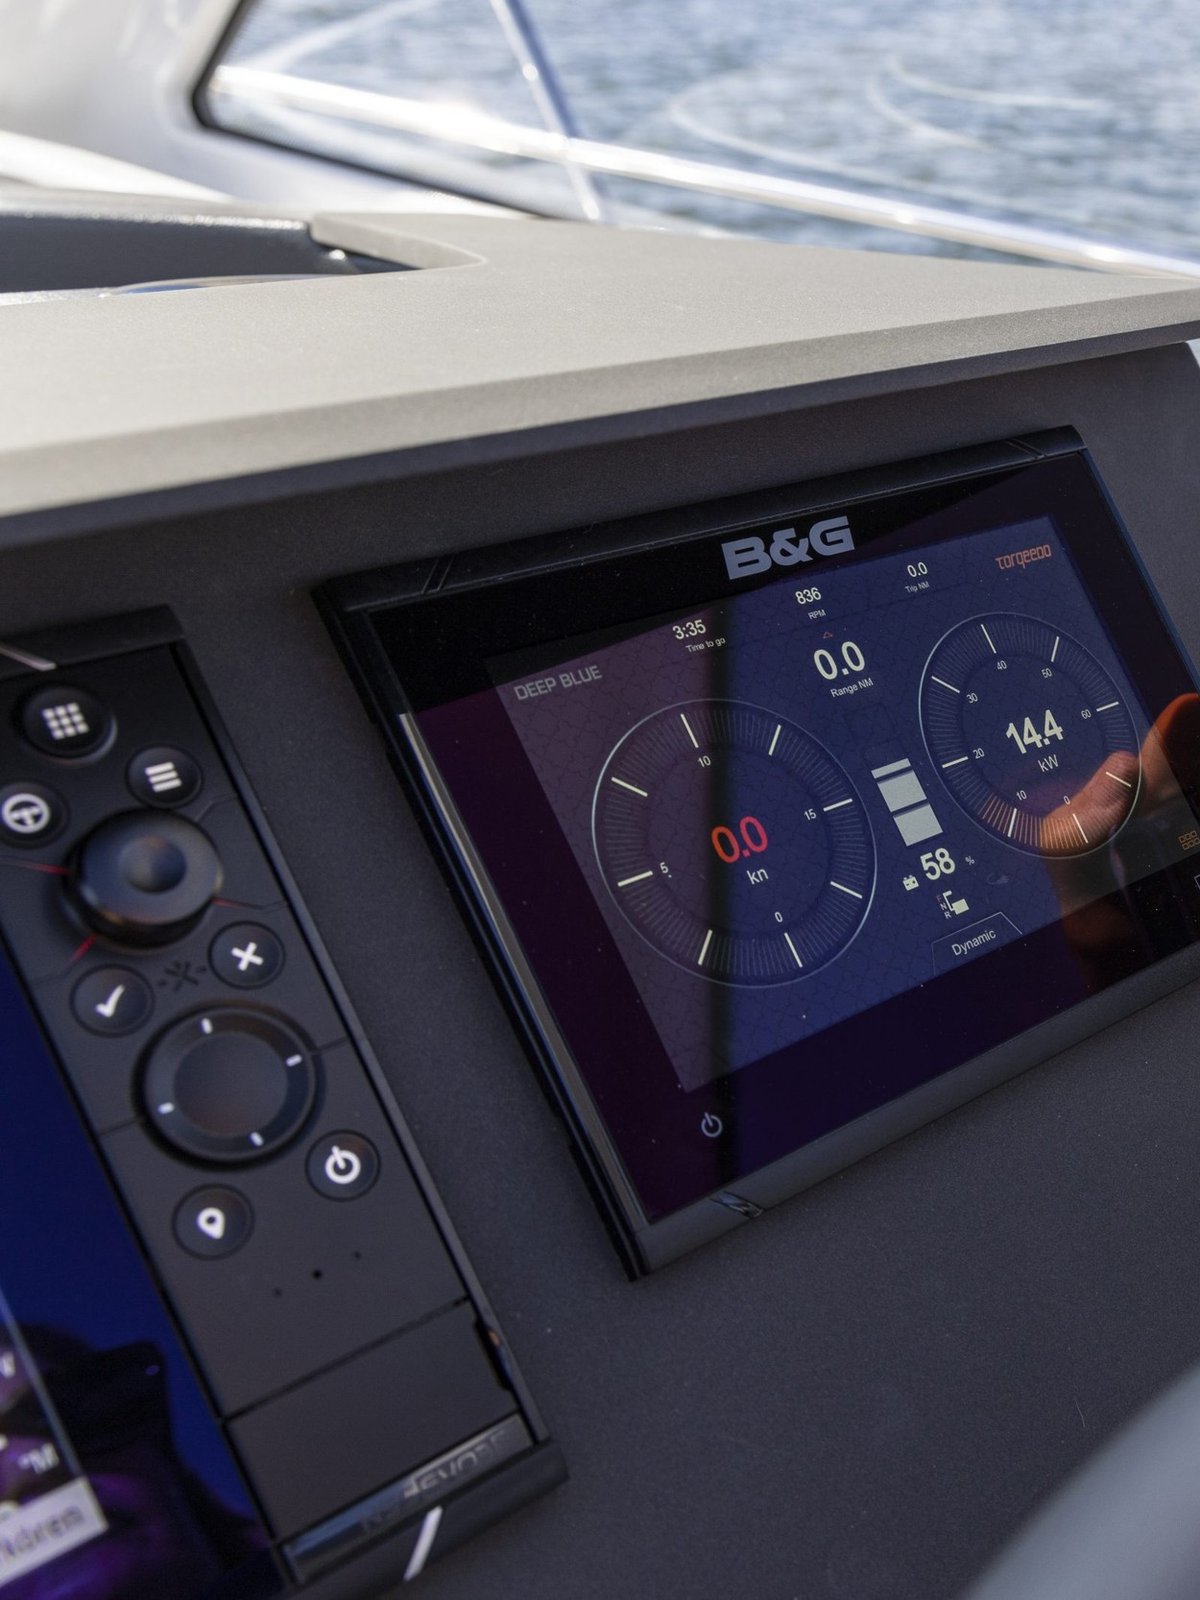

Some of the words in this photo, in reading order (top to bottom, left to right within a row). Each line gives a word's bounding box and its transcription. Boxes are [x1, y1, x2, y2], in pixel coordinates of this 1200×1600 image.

[721, 516, 855, 580] B&G
[906, 561, 928, 578] 0.0
[904, 583, 918, 593] Trip
[918, 581, 930, 589] NM
[795, 587, 821, 604] 836
[808, 609, 827, 620] RPM
[672, 619, 707, 640] 3:35
[686, 643, 705, 653] Time
[705, 640, 715, 648] to
[715, 637, 726, 646] go
[813, 641, 866, 680] 0.0
[996, 660, 1007, 670] 40
[1042, 668, 1052, 679] 50
[513, 677, 557, 701] DEEP
[559, 665, 603, 688] BLUE
[830, 683, 859, 698] Range
[858, 677, 874, 689] NM
[966, 692, 978, 704] 30
[1081, 709, 1091, 719] 60
[1005, 709, 1064, 754] 14.4
[973, 747, 985, 759] 20
[697, 755, 711, 768] 10
[1037, 754, 1059, 773] kW
[1016, 790, 1027, 801] 10
[1063, 795, 1071, 805] 0
[804, 808, 817, 821] 15
[711, 815, 768, 863] 0.0
[920, 848, 956, 881] 58
[747, 868, 769, 886] kn
[774, 911, 783, 923] 0
[951, 929, 997, 956] Dynamic
